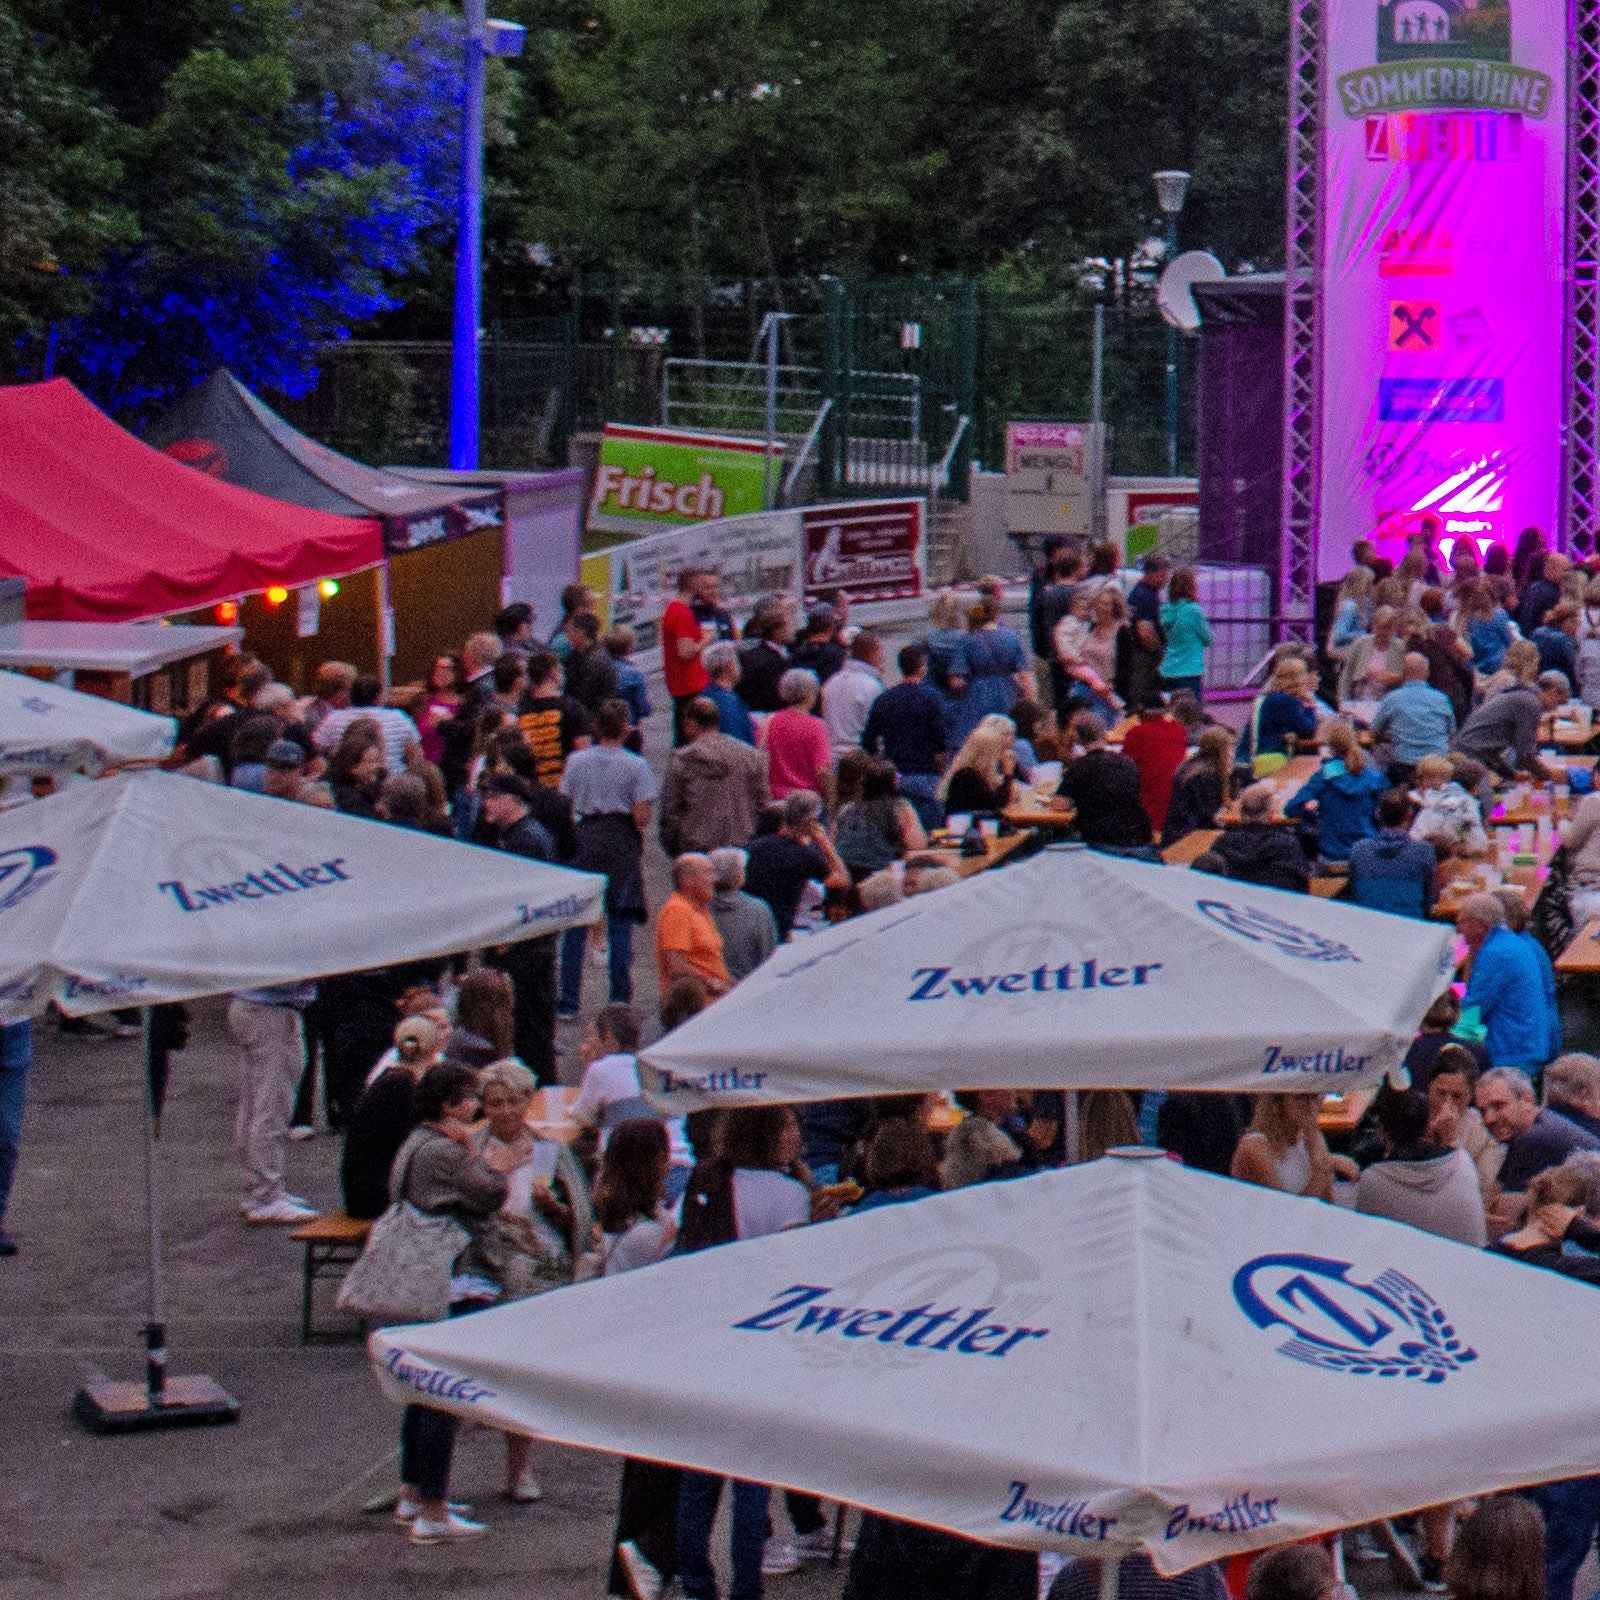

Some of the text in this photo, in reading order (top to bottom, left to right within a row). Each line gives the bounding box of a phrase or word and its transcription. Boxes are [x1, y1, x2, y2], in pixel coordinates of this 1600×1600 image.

[1342, 60, 1547, 114] SOMMERBÜHNE
[1365, 113, 1520, 161] ZWETTL
[597, 463, 725, 518] Frisch
[159, 855, 351, 915] Zwettler
[908, 955, 1166, 1004] Zwettler
[656, 1067, 770, 1097] Zwettler
[1261, 1045, 1374, 1078] Zwettler
[732, 1284, 1049, 1358] Zwettler
[384, 1347, 498, 1404] Zwettler
[999, 1480, 1119, 1542] Zwettler
[1164, 1492, 1281, 1542] Zwettler
